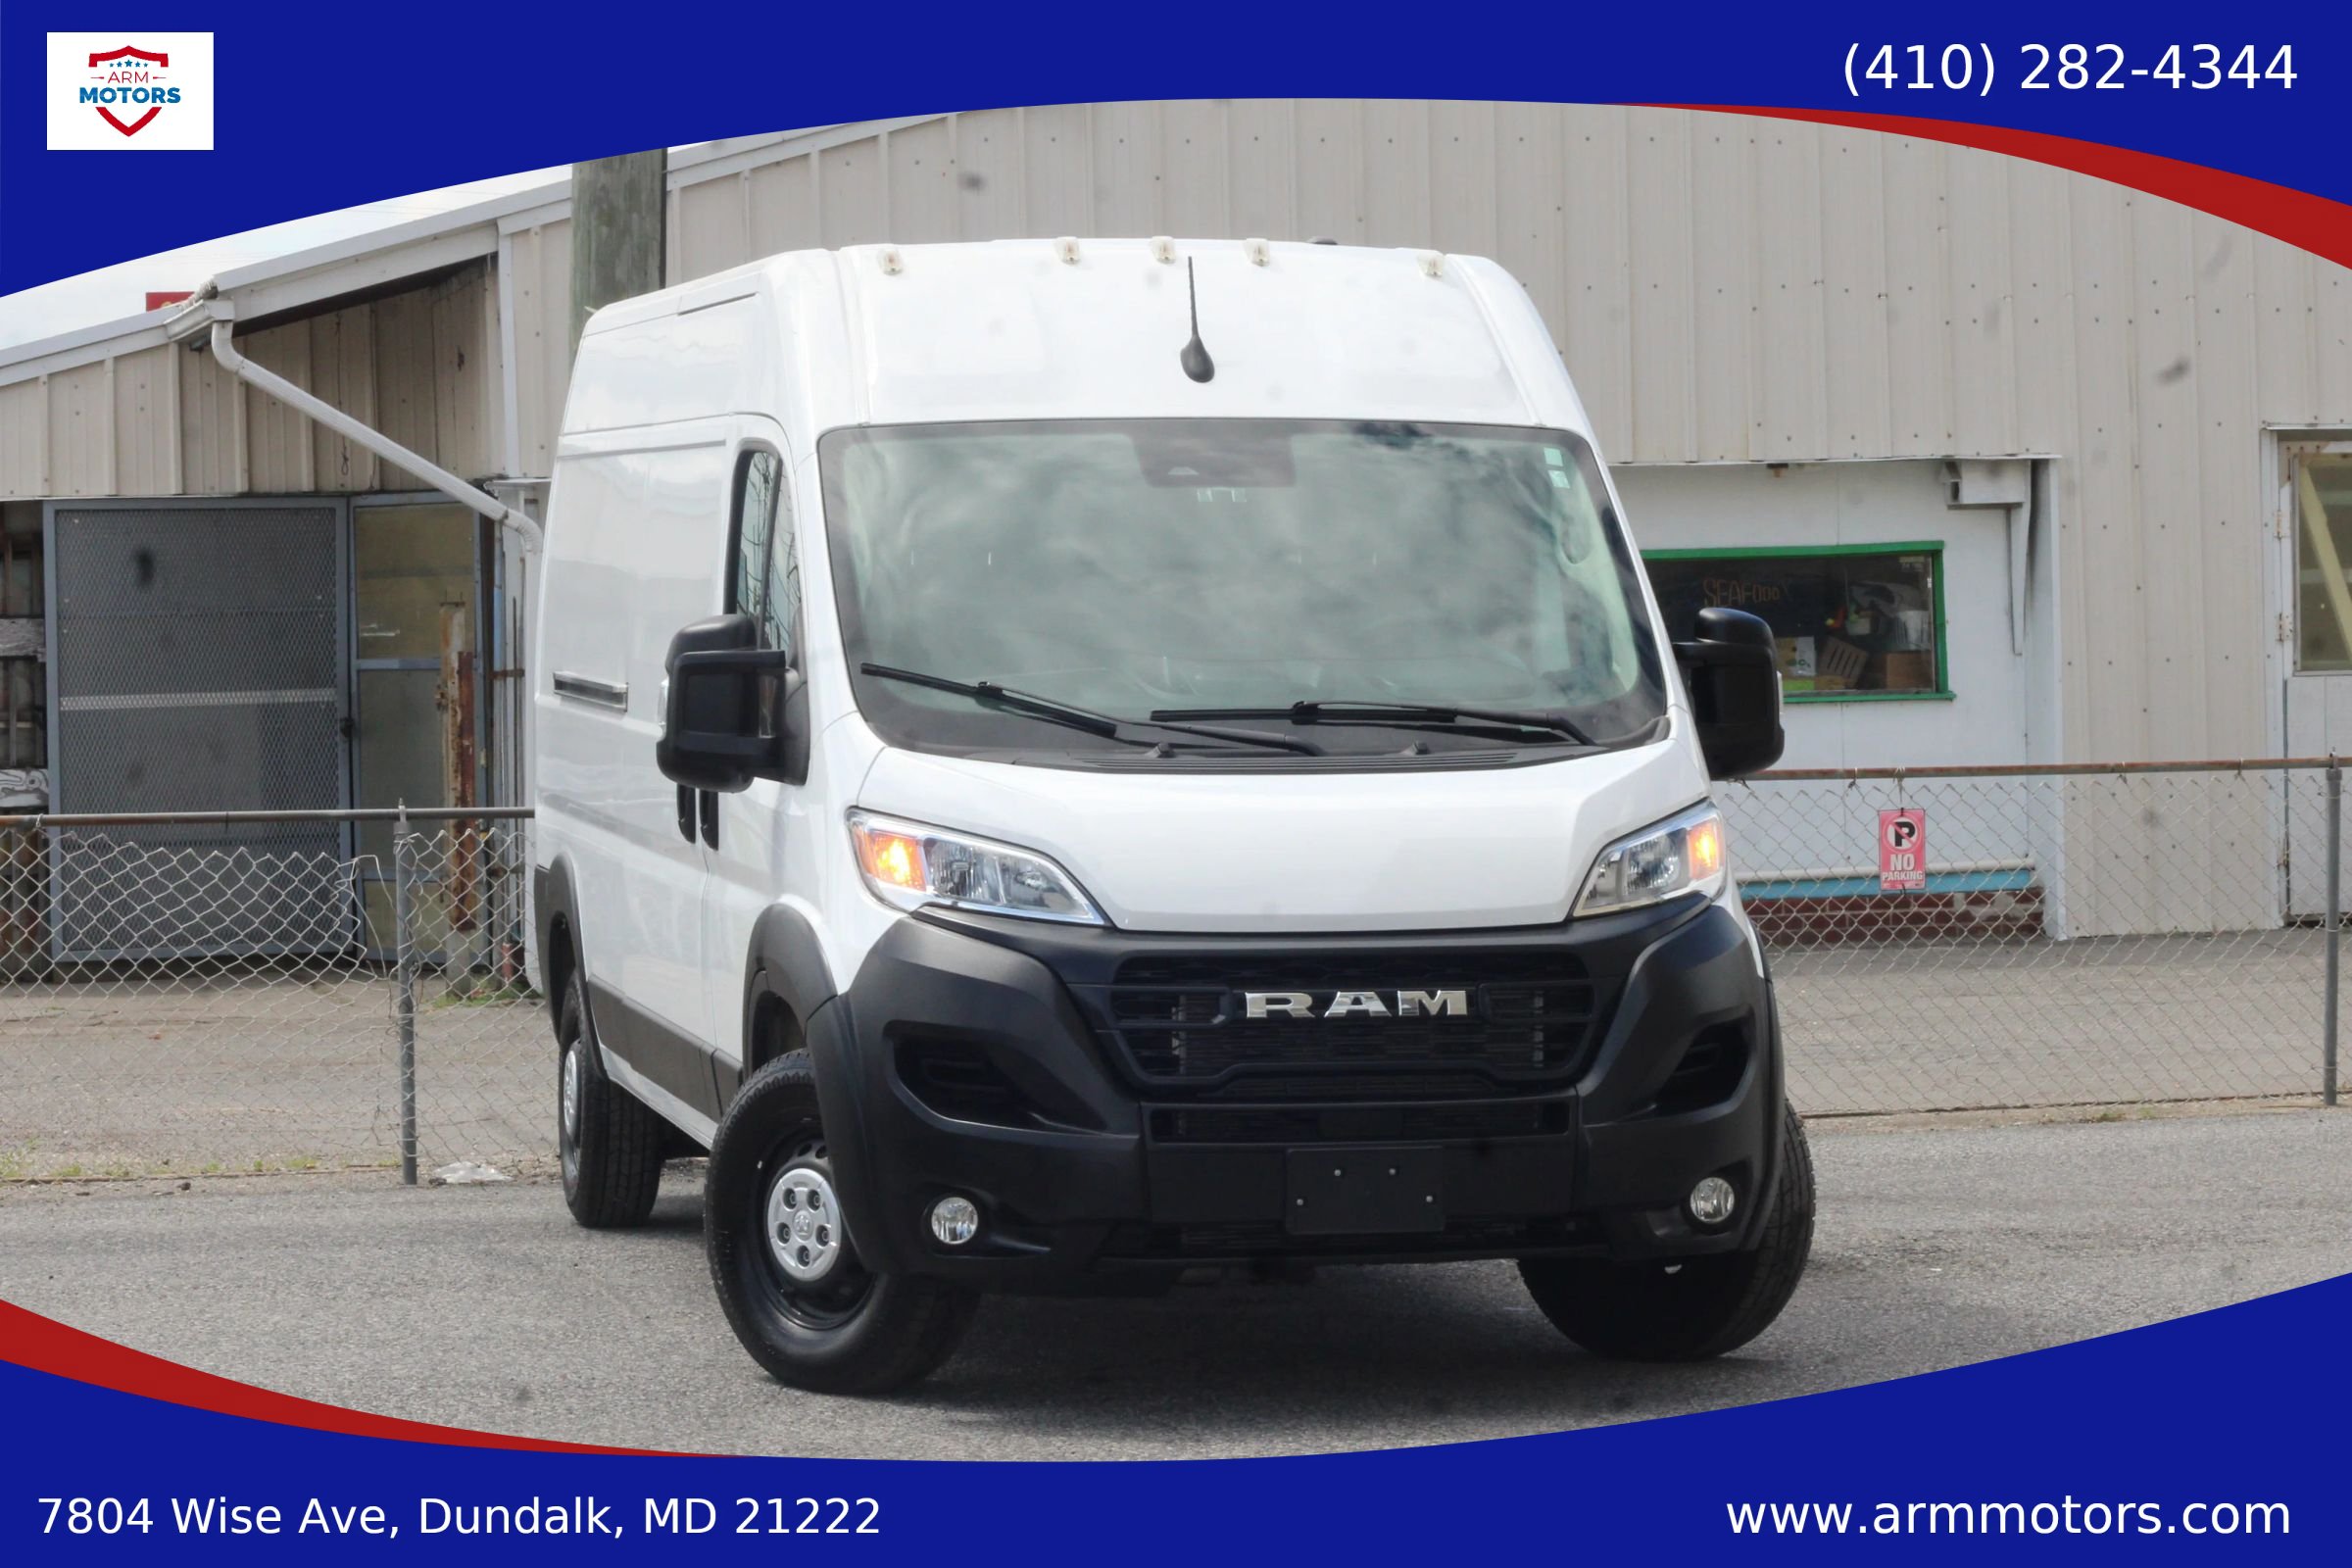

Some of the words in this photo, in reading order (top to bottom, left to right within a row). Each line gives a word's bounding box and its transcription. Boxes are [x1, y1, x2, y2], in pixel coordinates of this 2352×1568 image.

[1889, 854, 1915, 871] NO
[1882, 870, 1923, 881] PARKING
[1245, 989, 1468, 1018] RAM
